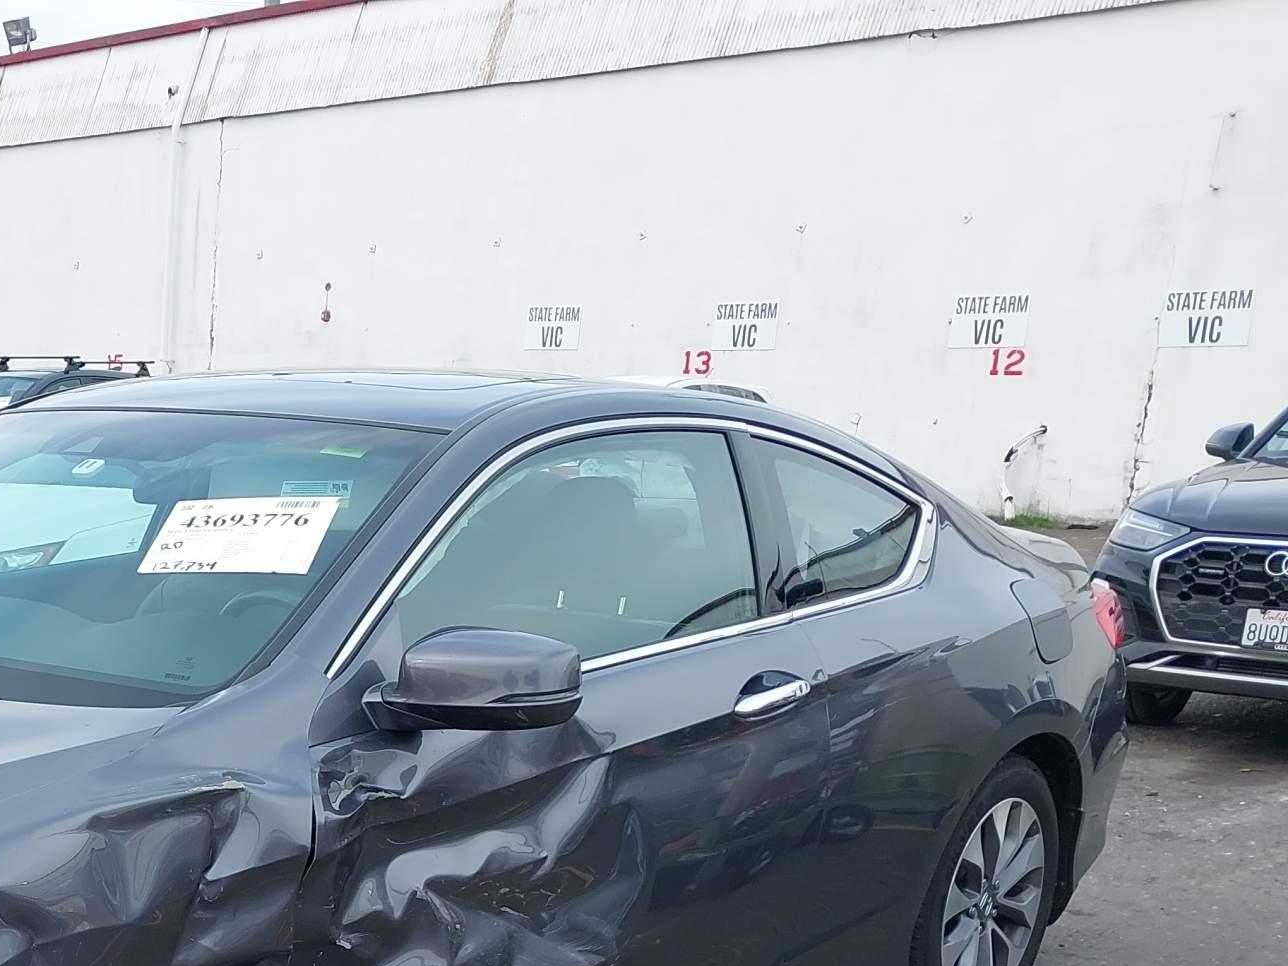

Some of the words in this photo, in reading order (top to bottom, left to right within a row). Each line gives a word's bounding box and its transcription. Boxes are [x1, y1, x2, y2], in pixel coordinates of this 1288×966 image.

[716, 303, 746, 321] STATE
[747, 302, 778, 320] FARM
[955, 297, 991, 315] STATE
[992, 295, 1029, 314] FARM
[1166, 292, 1207, 311] STATE
[1209, 290, 1253, 310] FARM
[528, 306, 553, 323] STATE
[554, 306, 580, 322] FARM
[541, 325, 563, 348] VIC
[732, 323, 757, 348] VIC
[973, 319, 1004, 345] VIC
[1187, 316, 1223, 344] VIC
[682, 350, 712, 375] 13
[989, 348, 1026, 376] 12
[179, 512, 311, 529] 43693776
